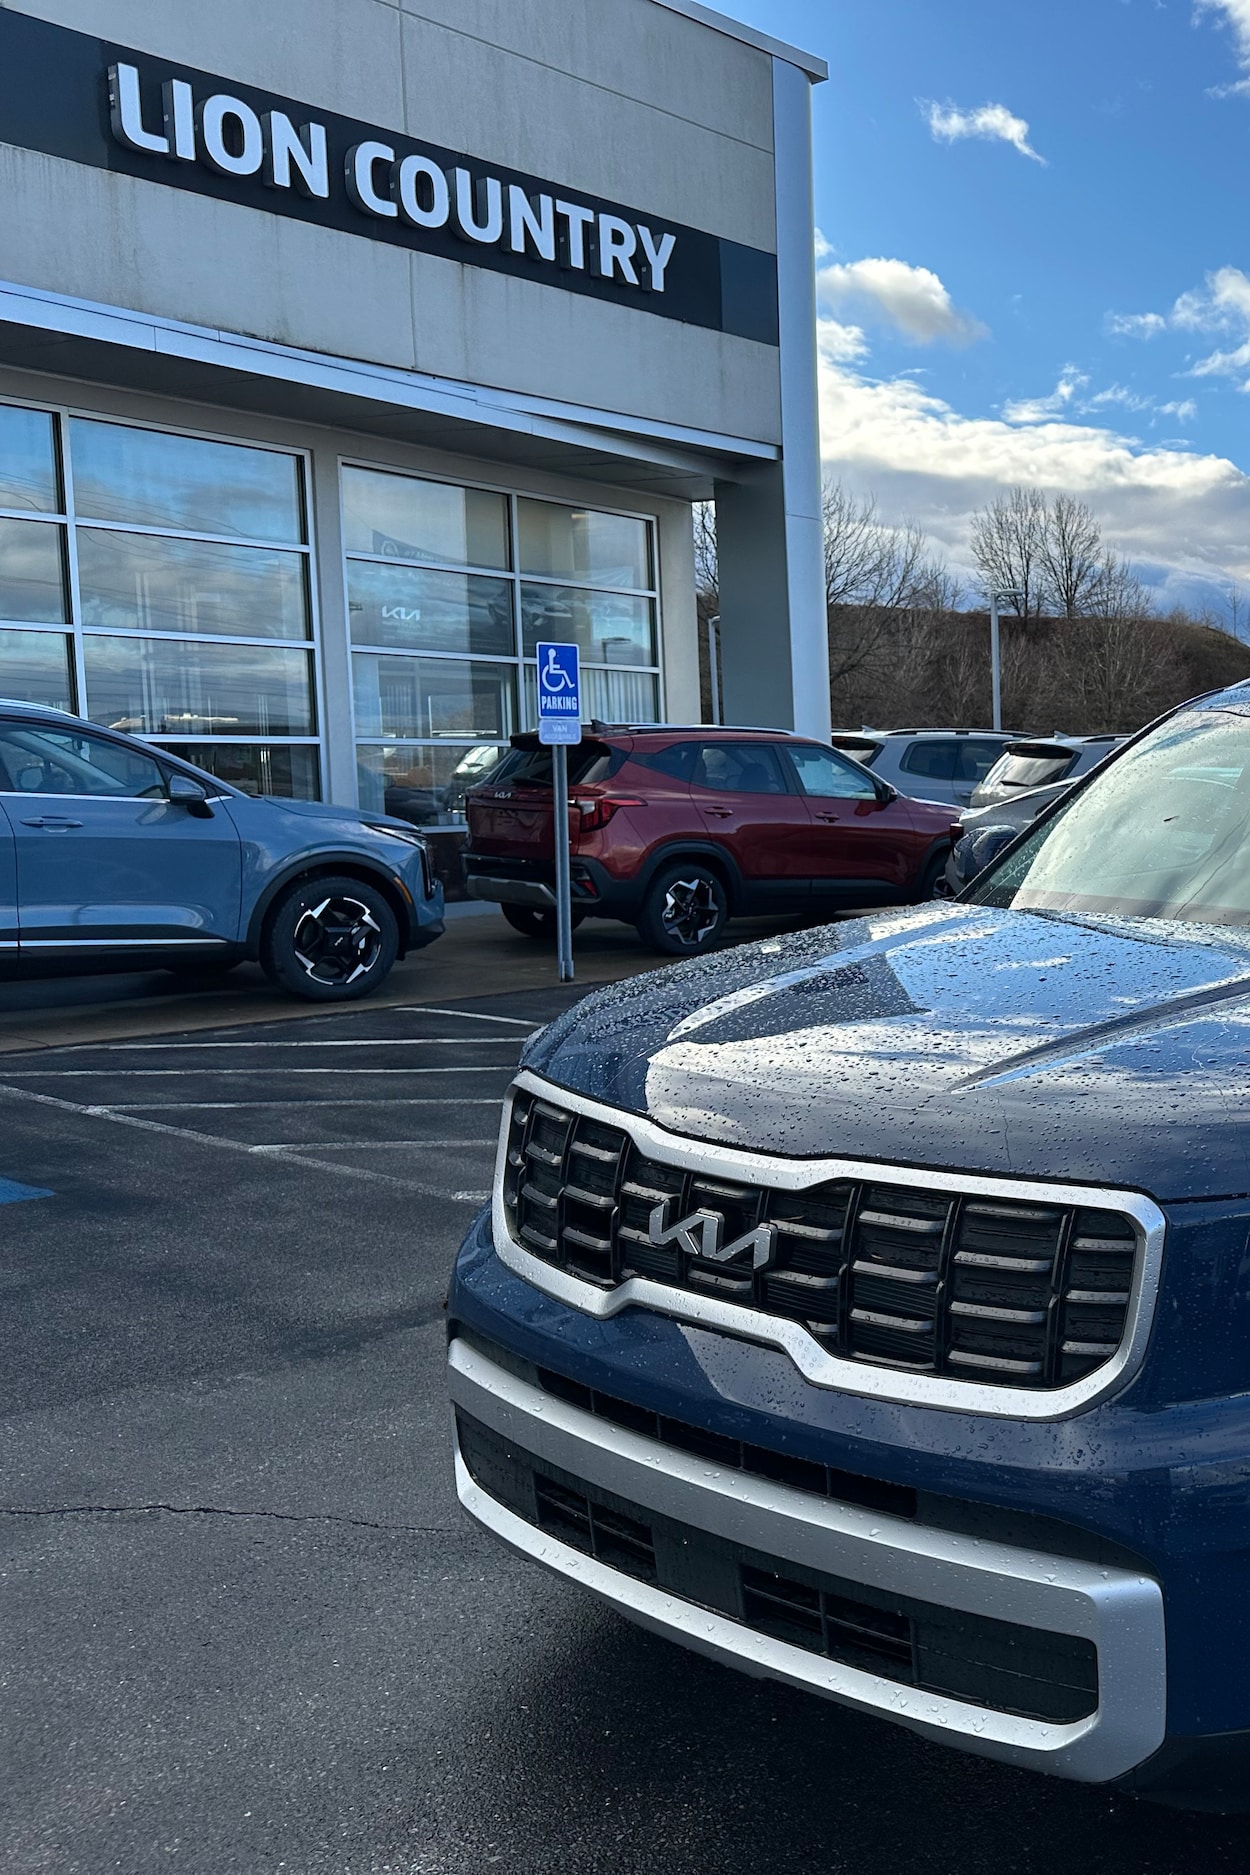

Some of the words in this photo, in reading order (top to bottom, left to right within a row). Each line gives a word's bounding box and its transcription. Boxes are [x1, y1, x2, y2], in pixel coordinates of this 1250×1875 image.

[111, 62, 329, 199] LION
[346, 140, 677, 293] COUNTRY
[381, 605, 421, 621] KIA
[541, 695, 577, 711] PARKING
[551, 724, 568, 733] VAN
[649, 1198, 778, 1270] KIA
